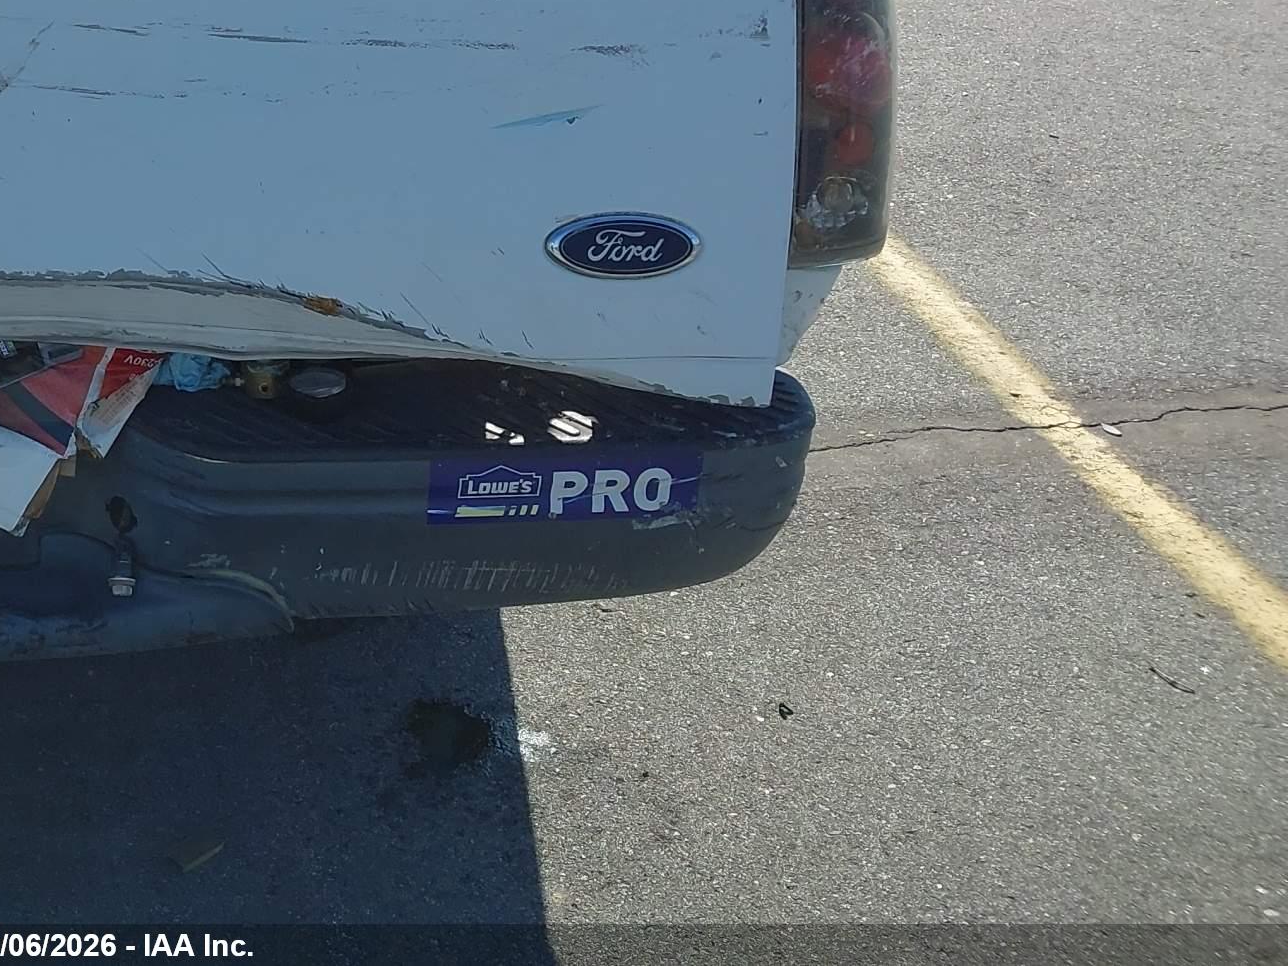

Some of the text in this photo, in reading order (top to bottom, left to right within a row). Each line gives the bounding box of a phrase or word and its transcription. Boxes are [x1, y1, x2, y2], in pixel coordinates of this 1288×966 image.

[587, 229, 664, 262] Ford
[467, 466, 673, 515] LOWE'S PRO
